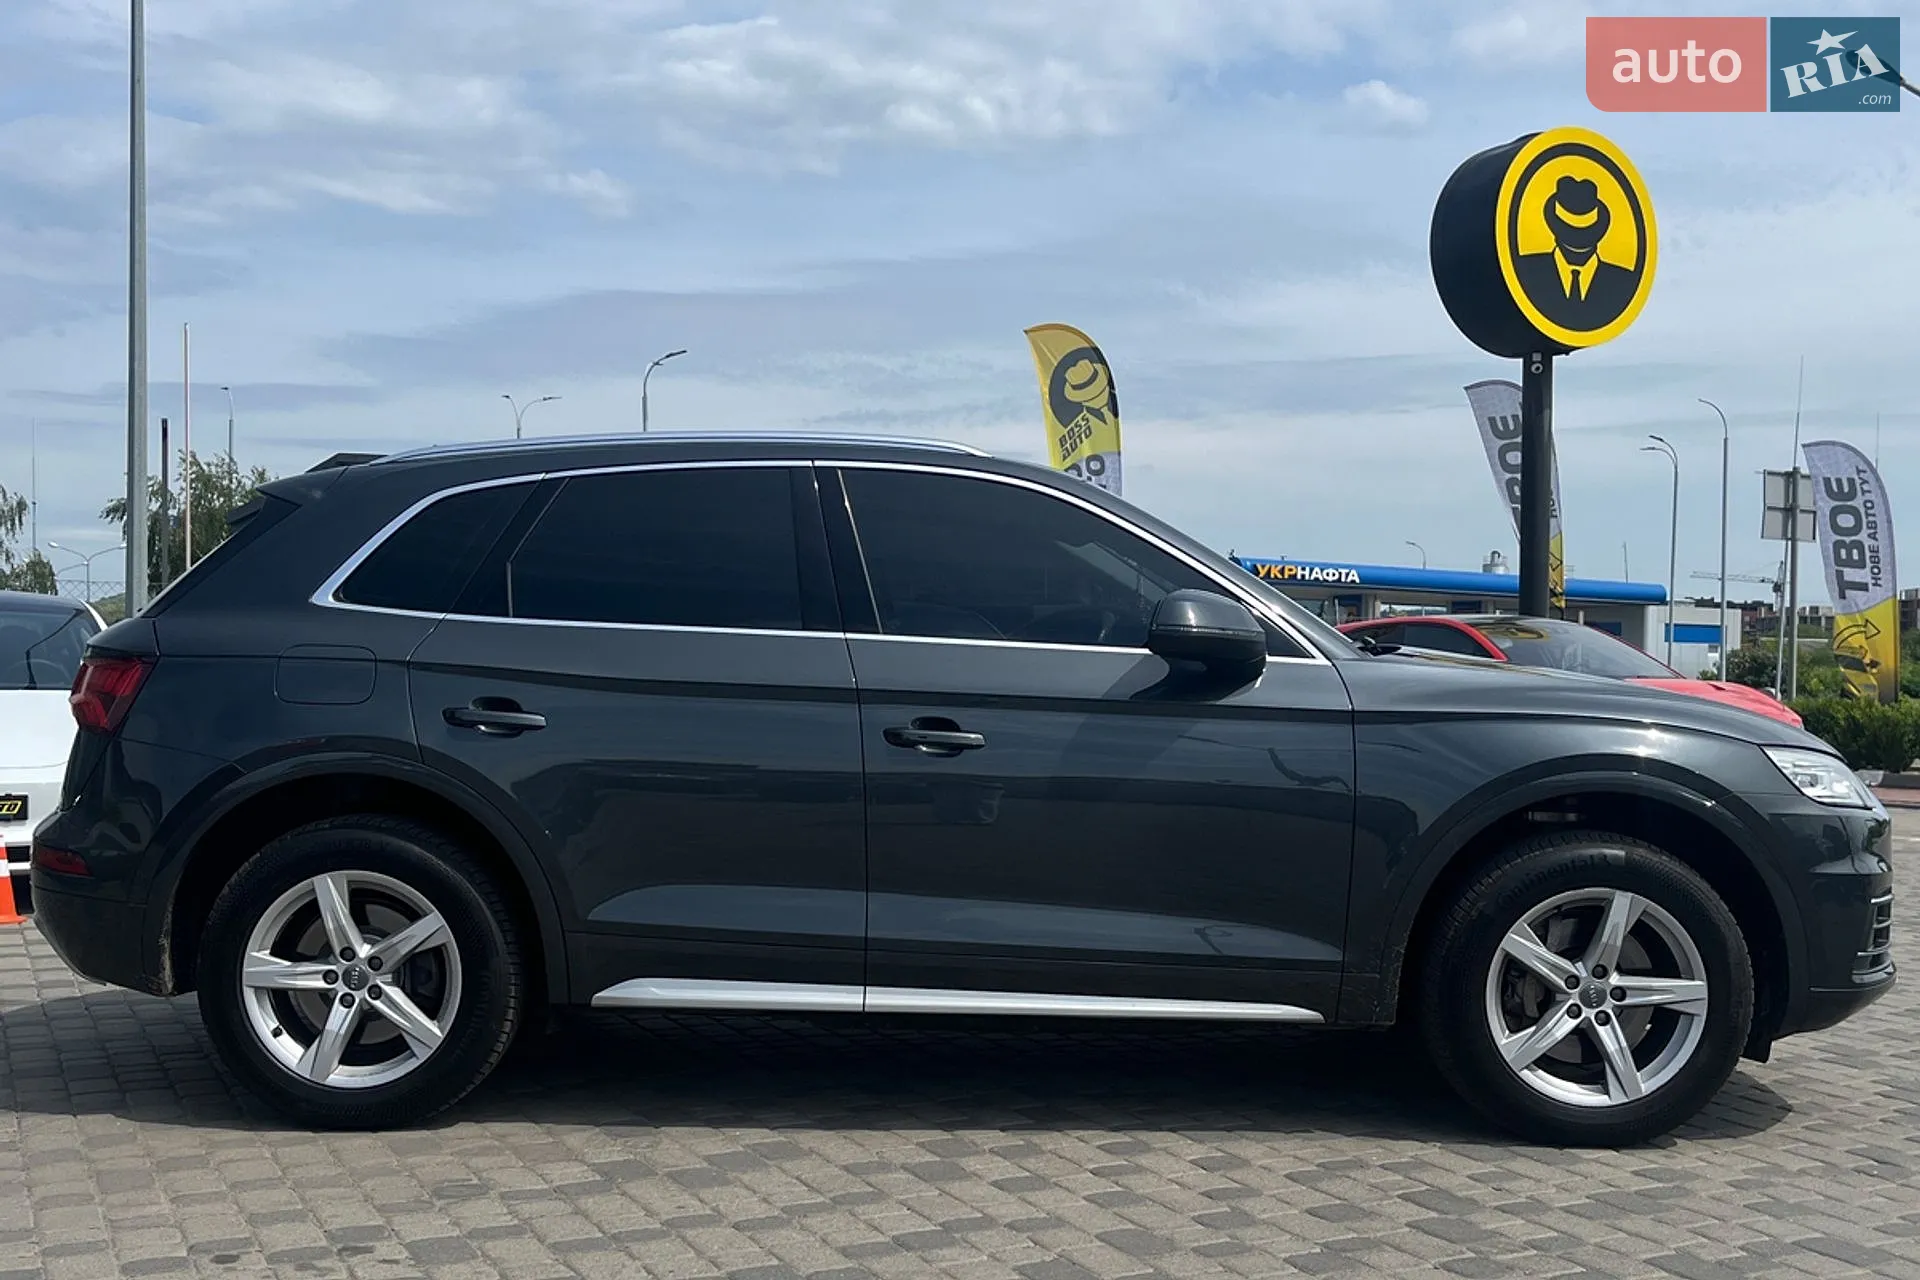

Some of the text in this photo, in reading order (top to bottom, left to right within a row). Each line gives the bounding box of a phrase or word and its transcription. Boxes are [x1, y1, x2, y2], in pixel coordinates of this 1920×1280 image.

[1058, 413, 1090, 449] BOSS
[1062, 424, 1093, 462] AUTO
[1855, 465, 1883, 588] НОВЕ АВТО ТУТ
[1255, 563, 1360, 583] УКРНАФТА
